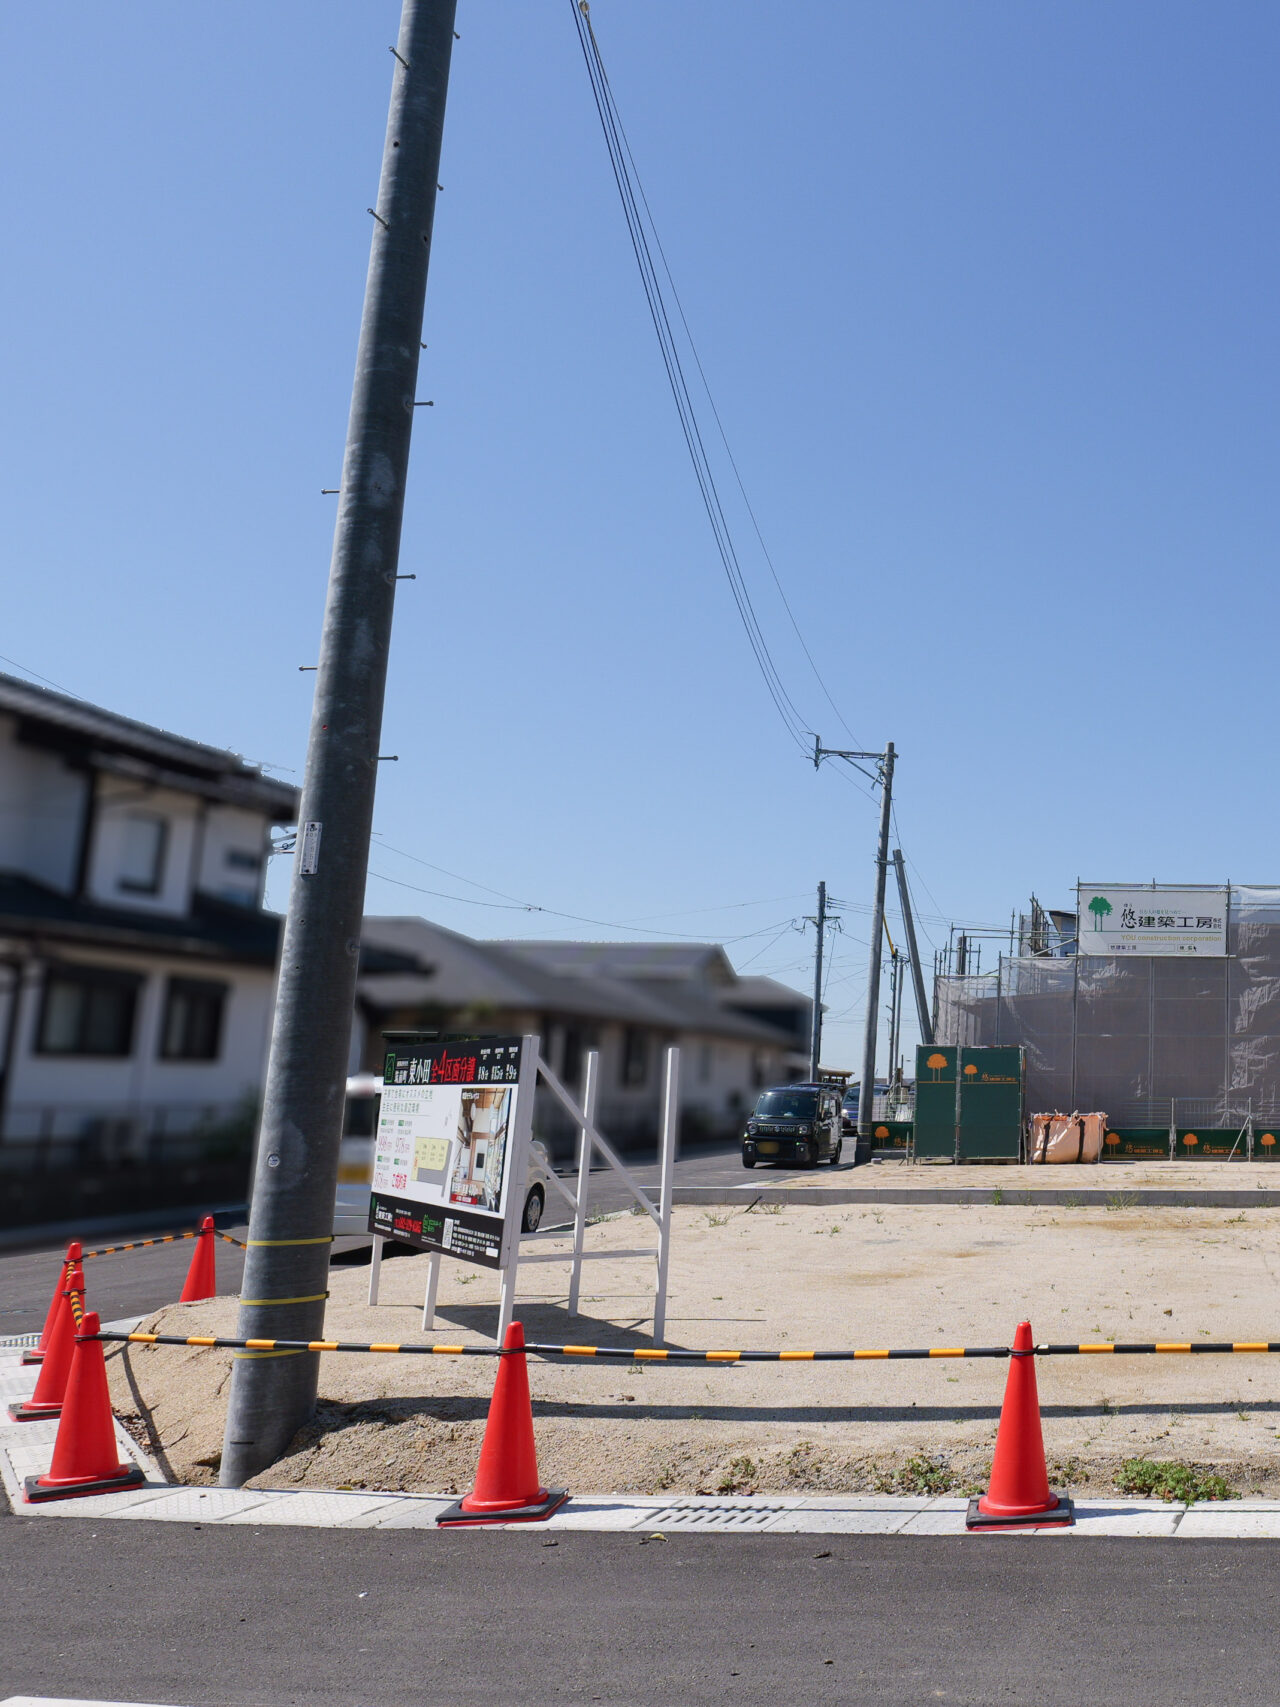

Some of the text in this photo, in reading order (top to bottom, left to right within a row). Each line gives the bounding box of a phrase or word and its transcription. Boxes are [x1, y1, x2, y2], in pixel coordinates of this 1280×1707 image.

[1120, 908, 1213, 929] 悠建築工房
[408, 1057, 432, 1084] 東小田
